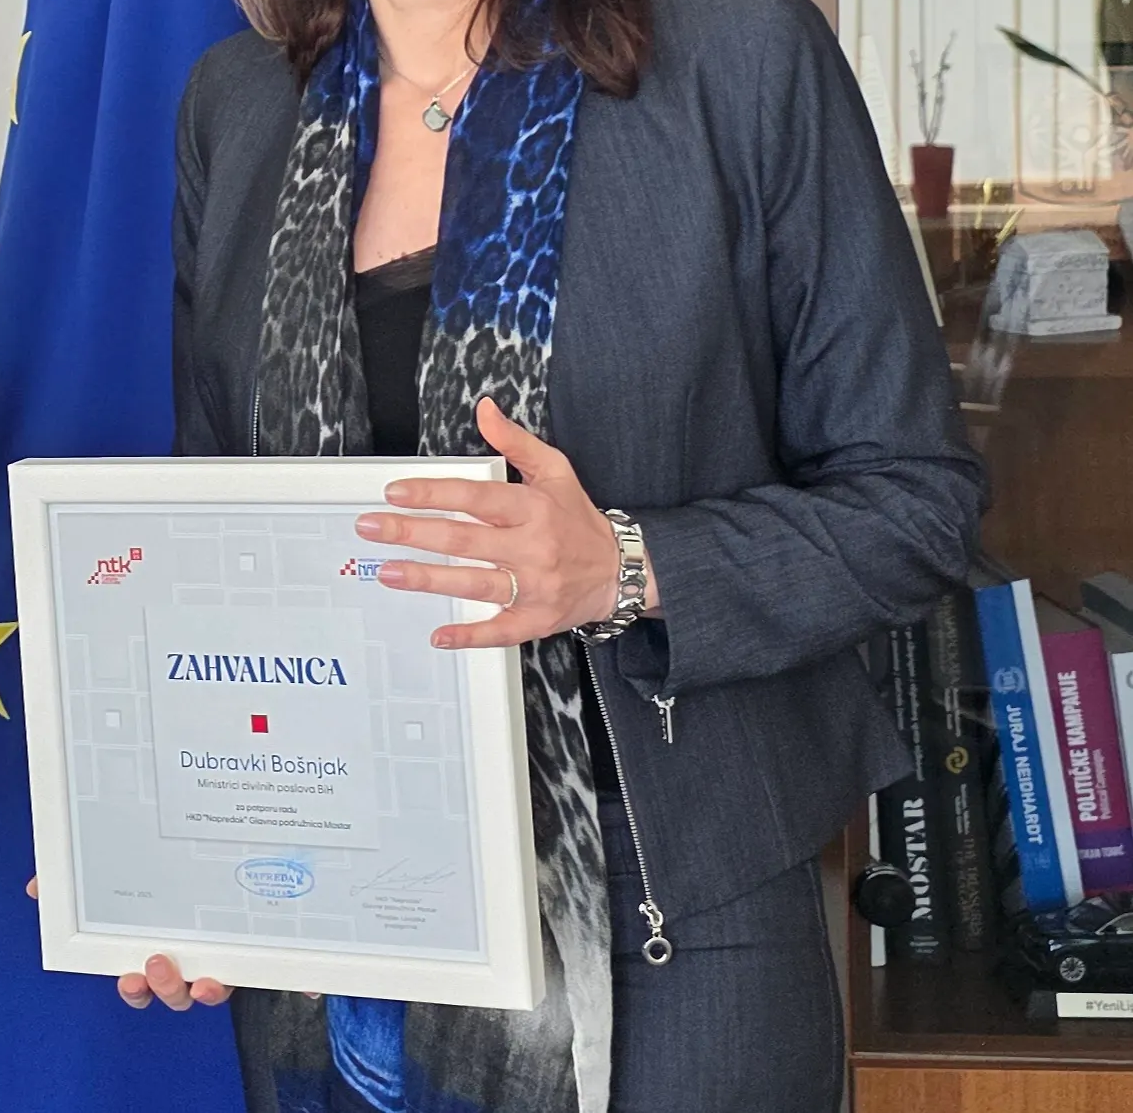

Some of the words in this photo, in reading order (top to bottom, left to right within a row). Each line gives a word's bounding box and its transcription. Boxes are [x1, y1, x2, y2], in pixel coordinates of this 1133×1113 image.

[97, 556, 132, 573] ntk
[167, 653, 348, 686] ZAHVALNICA
[1006, 704, 1028, 753] JURAJ
[1057, 670, 1087, 746] KAMPANJE
[180, 750, 266, 772] Dubravki
[271, 754, 349, 779] Bošnjak
[197, 778, 240, 790] Ministrici
[241, 780, 275, 791] civilnih
[277, 783, 316, 794] poslova
[317, 784, 334, 795] BiH
[1068, 747, 1098, 822] POLITIČKE
[1015, 755, 1043, 845] NEIDHARDT
[902, 797, 933, 921] MOSTAR
